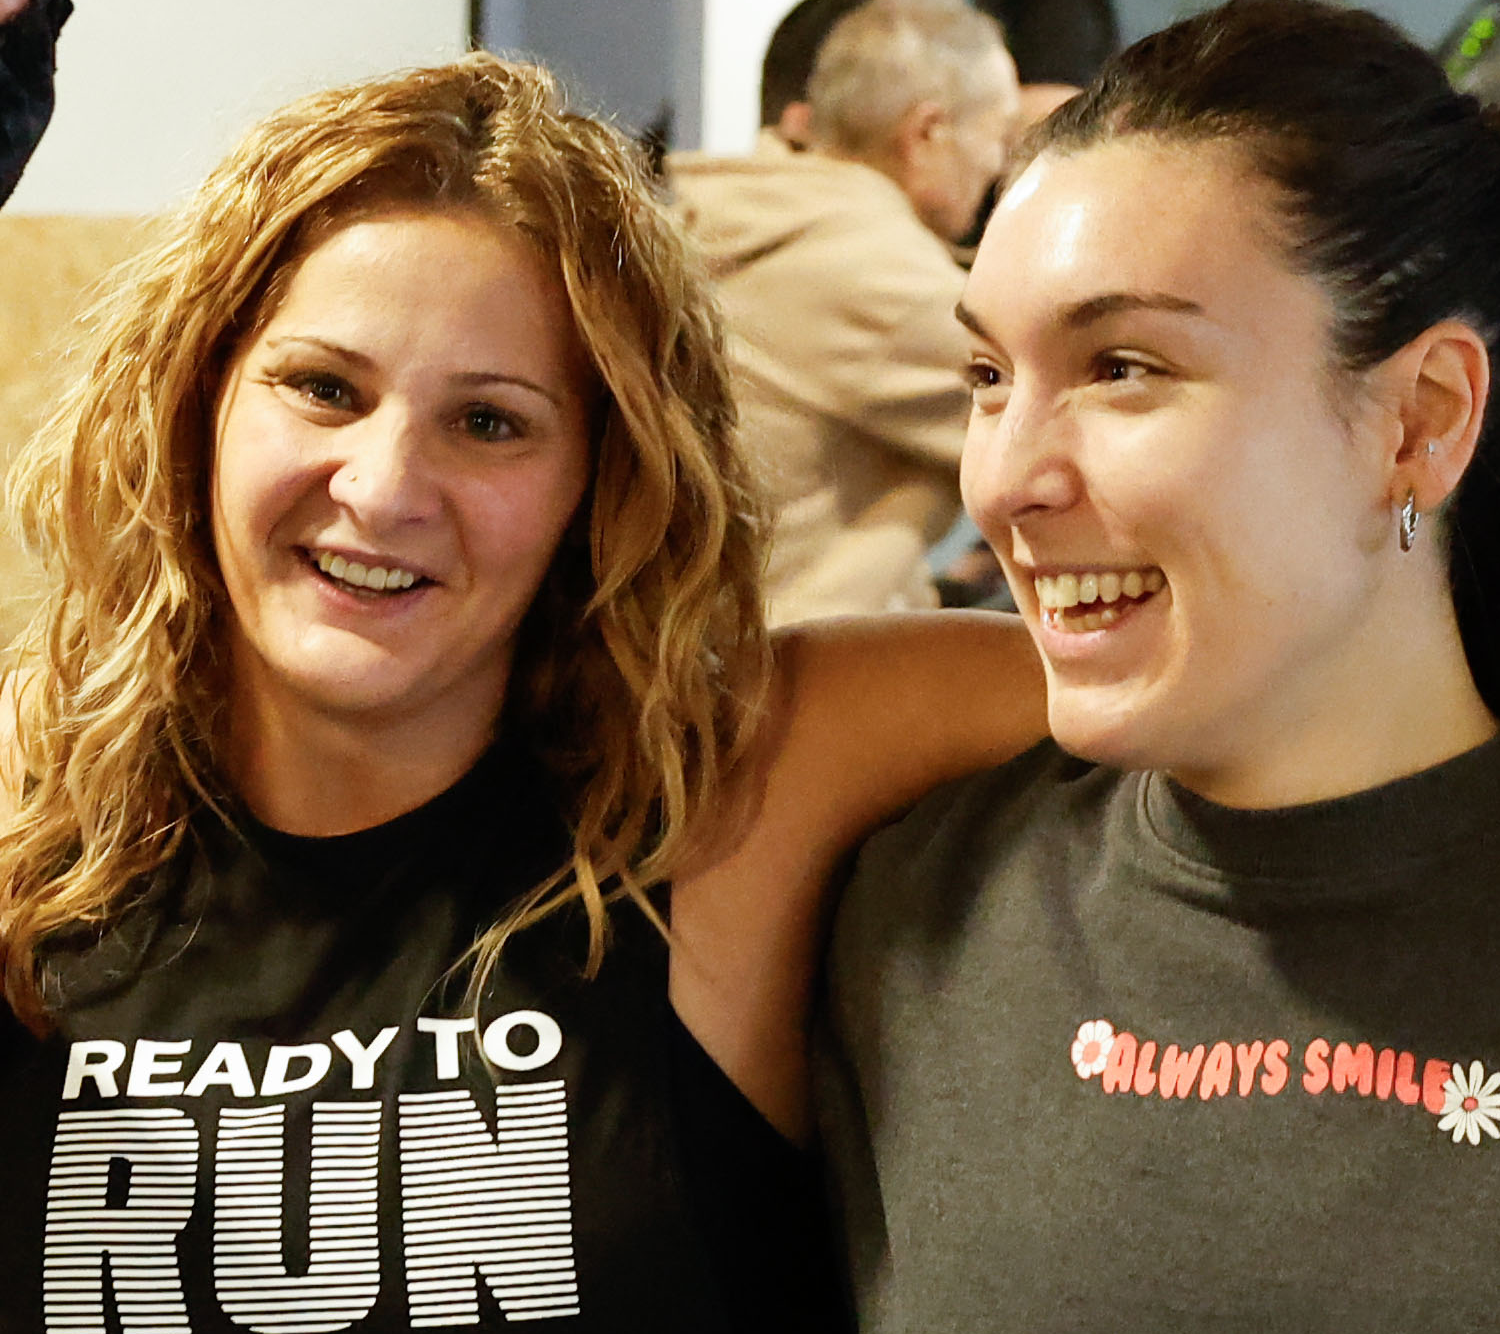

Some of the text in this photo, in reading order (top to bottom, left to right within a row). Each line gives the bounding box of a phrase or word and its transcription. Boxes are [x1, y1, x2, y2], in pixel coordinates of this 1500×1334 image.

[61, 1009, 562, 1100] READY TO
[1103, 1031, 1452, 1115] ALWAYS SMILE
